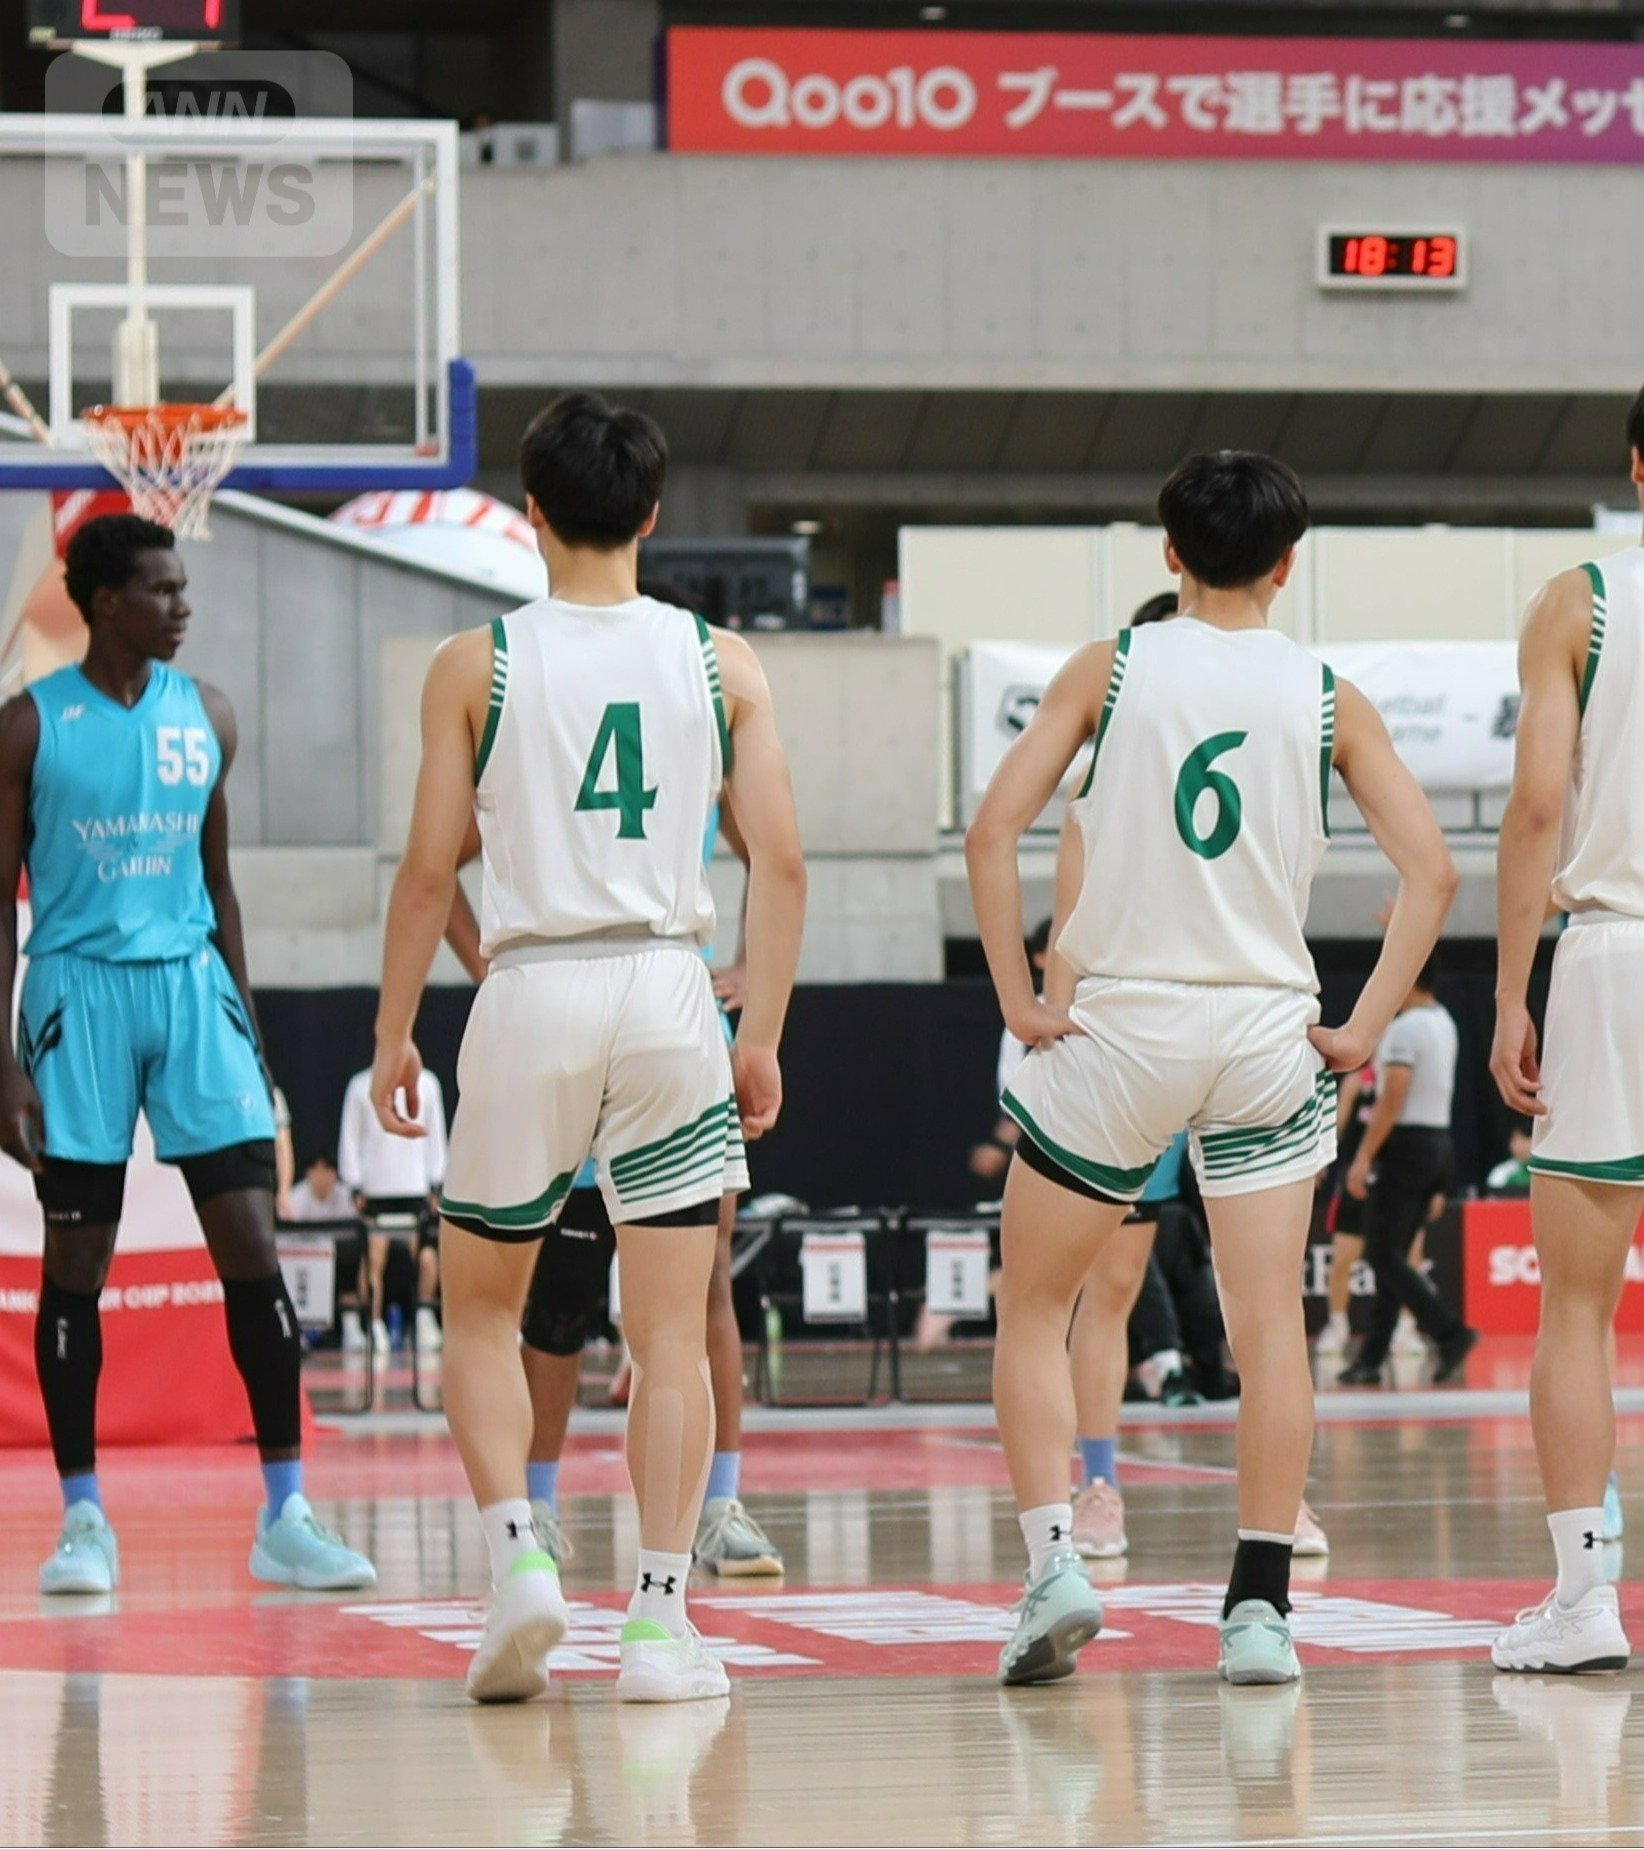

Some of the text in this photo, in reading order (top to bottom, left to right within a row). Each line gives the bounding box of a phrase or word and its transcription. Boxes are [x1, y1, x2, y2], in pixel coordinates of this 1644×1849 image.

[722, 57, 978, 131] Qoo10
[1343, 235, 1456, 277] 18:13
[156, 726, 210, 786] 55
[574, 700, 657, 841] 4
[1174, 729, 1249, 860] 6
